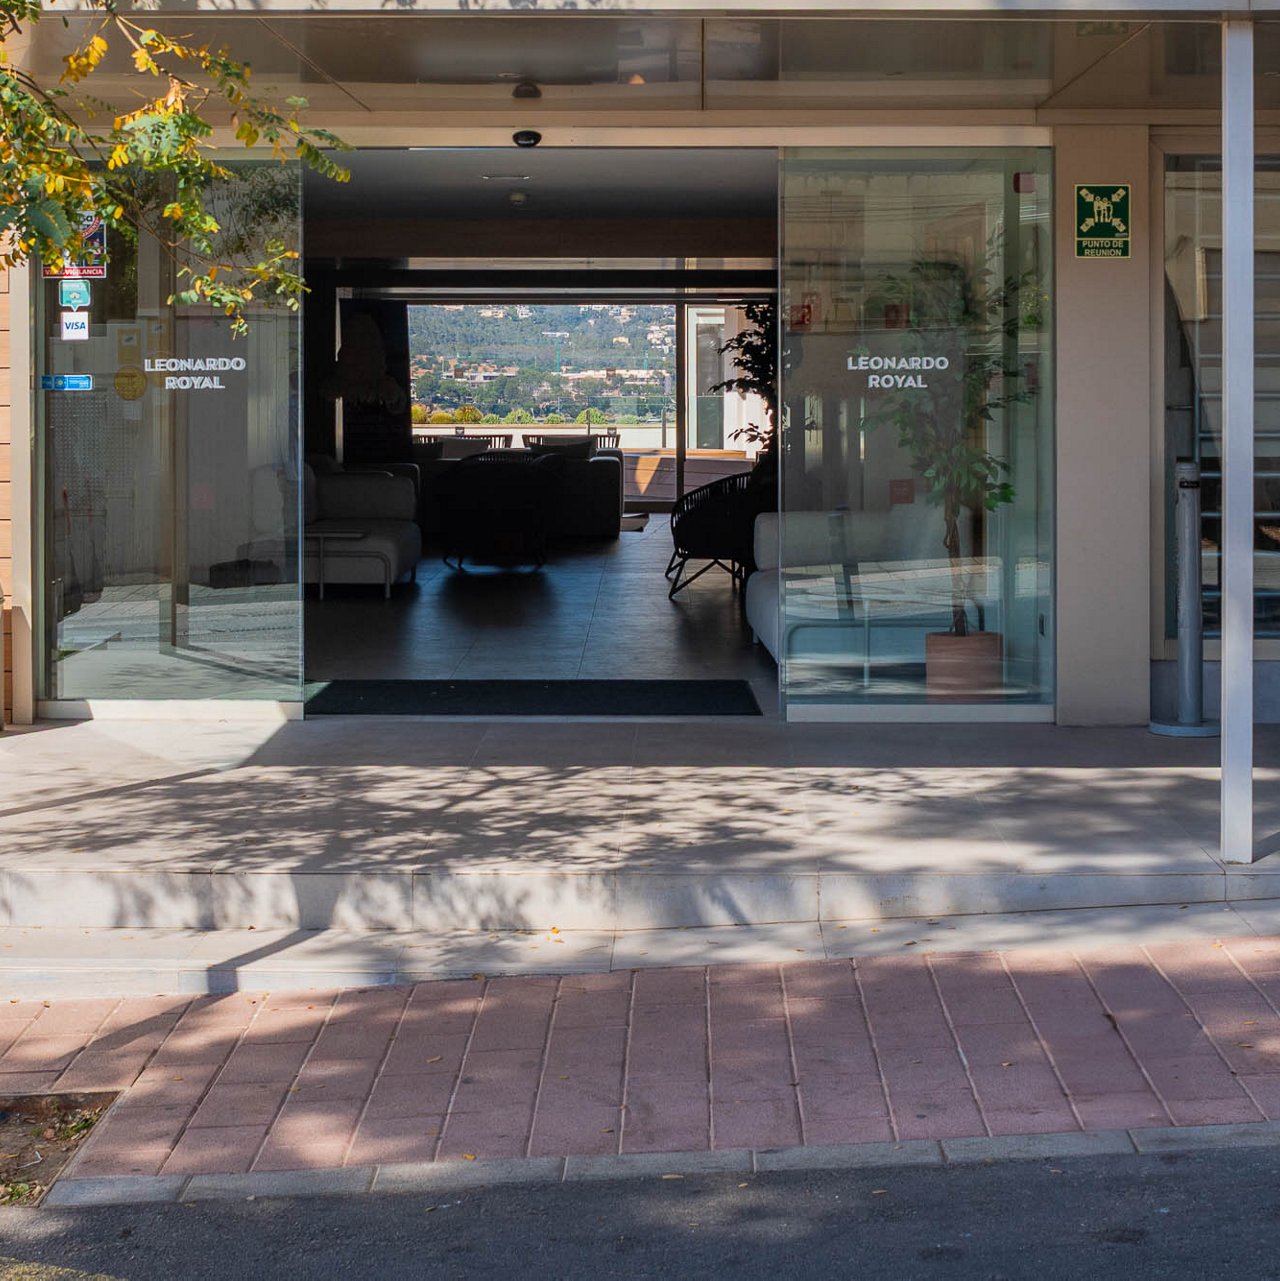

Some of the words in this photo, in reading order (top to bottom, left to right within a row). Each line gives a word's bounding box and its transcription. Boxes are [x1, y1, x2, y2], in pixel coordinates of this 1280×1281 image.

[1082, 240, 1110, 248] PUNTO
[1112, 240, 1124, 248] DE
[65, 322, 86, 330] VISA
[144, 358, 247, 372] LEONARDO
[847, 356, 950, 370] LEONARDO
[165, 376, 226, 390] ROYAL
[867, 374, 928, 389] ROYAL
